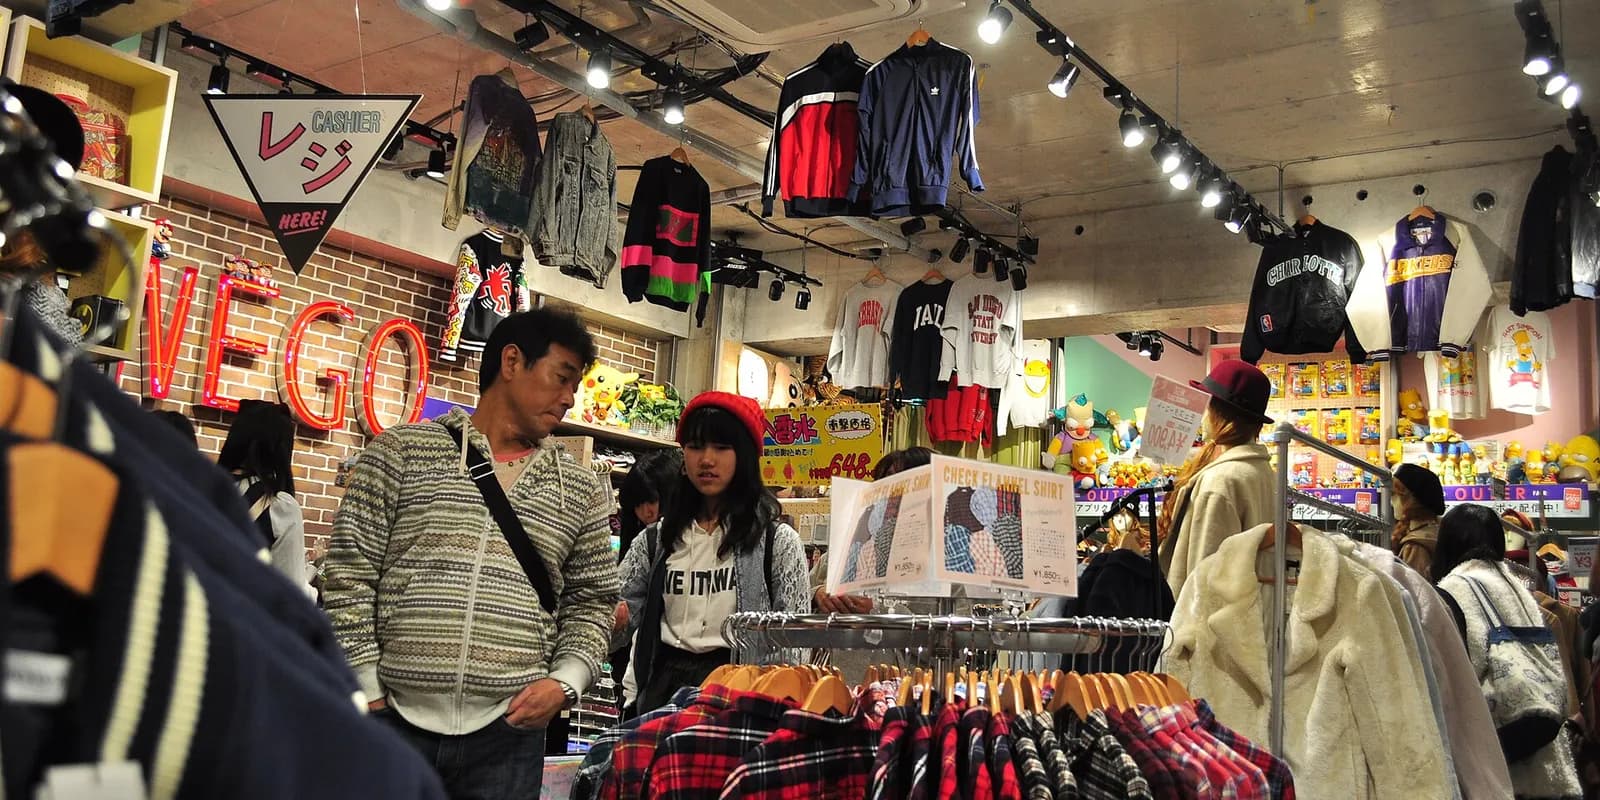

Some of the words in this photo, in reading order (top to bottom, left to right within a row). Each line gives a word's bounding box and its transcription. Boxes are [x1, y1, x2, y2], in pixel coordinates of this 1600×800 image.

[311, 110, 381, 133] CASHIER
[259, 111, 353, 195] レジ
[278, 209, 328, 230] HERE!
[829, 452, 871, 480] 648
[943, 465, 978, 489] CHECK
[981, 471, 1030, 496] FLANNEL
[1033, 480, 1064, 501] SHIRT
[1454, 487, 1526, 501] OUER
